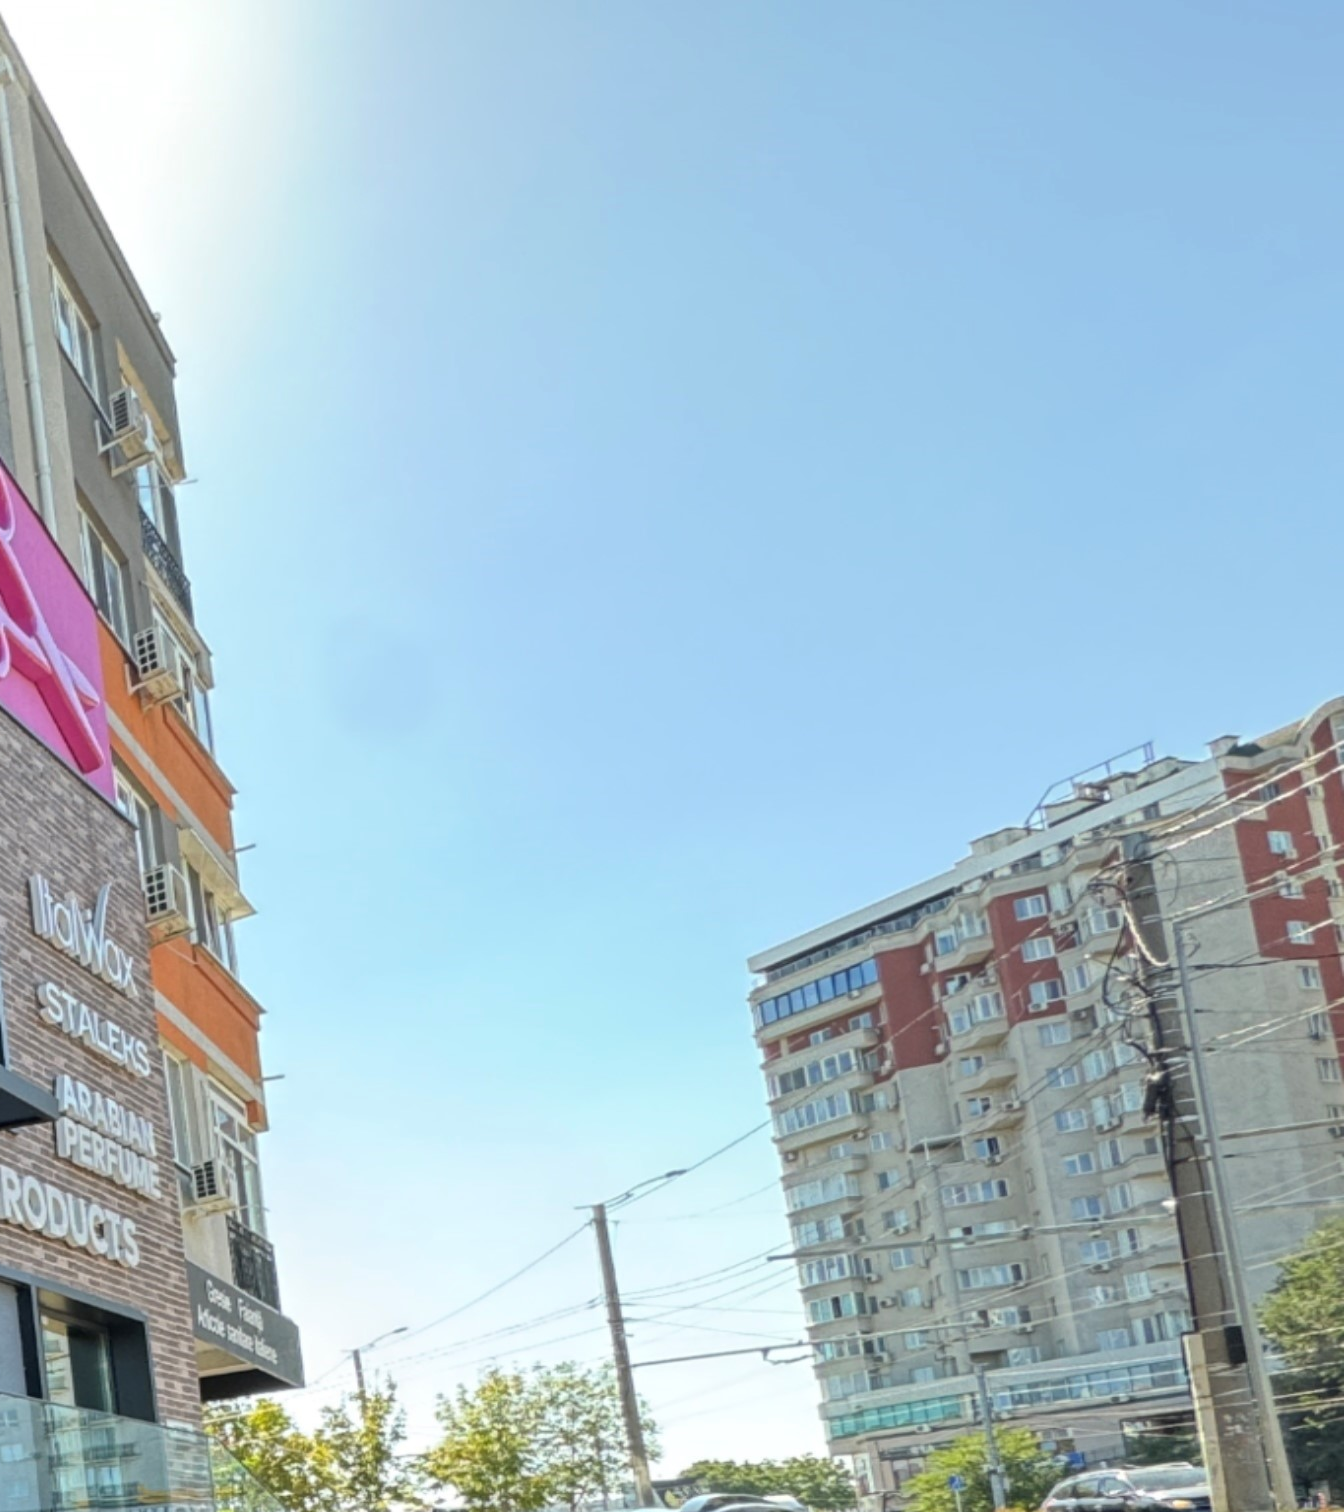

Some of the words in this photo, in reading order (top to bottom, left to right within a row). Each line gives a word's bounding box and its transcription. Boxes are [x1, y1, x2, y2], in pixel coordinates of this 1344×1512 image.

[38, 981, 151, 1078] STALEKS
[55, 1074, 157, 1156] ARABIAN
[56, 1116, 162, 1200] PERFUME
